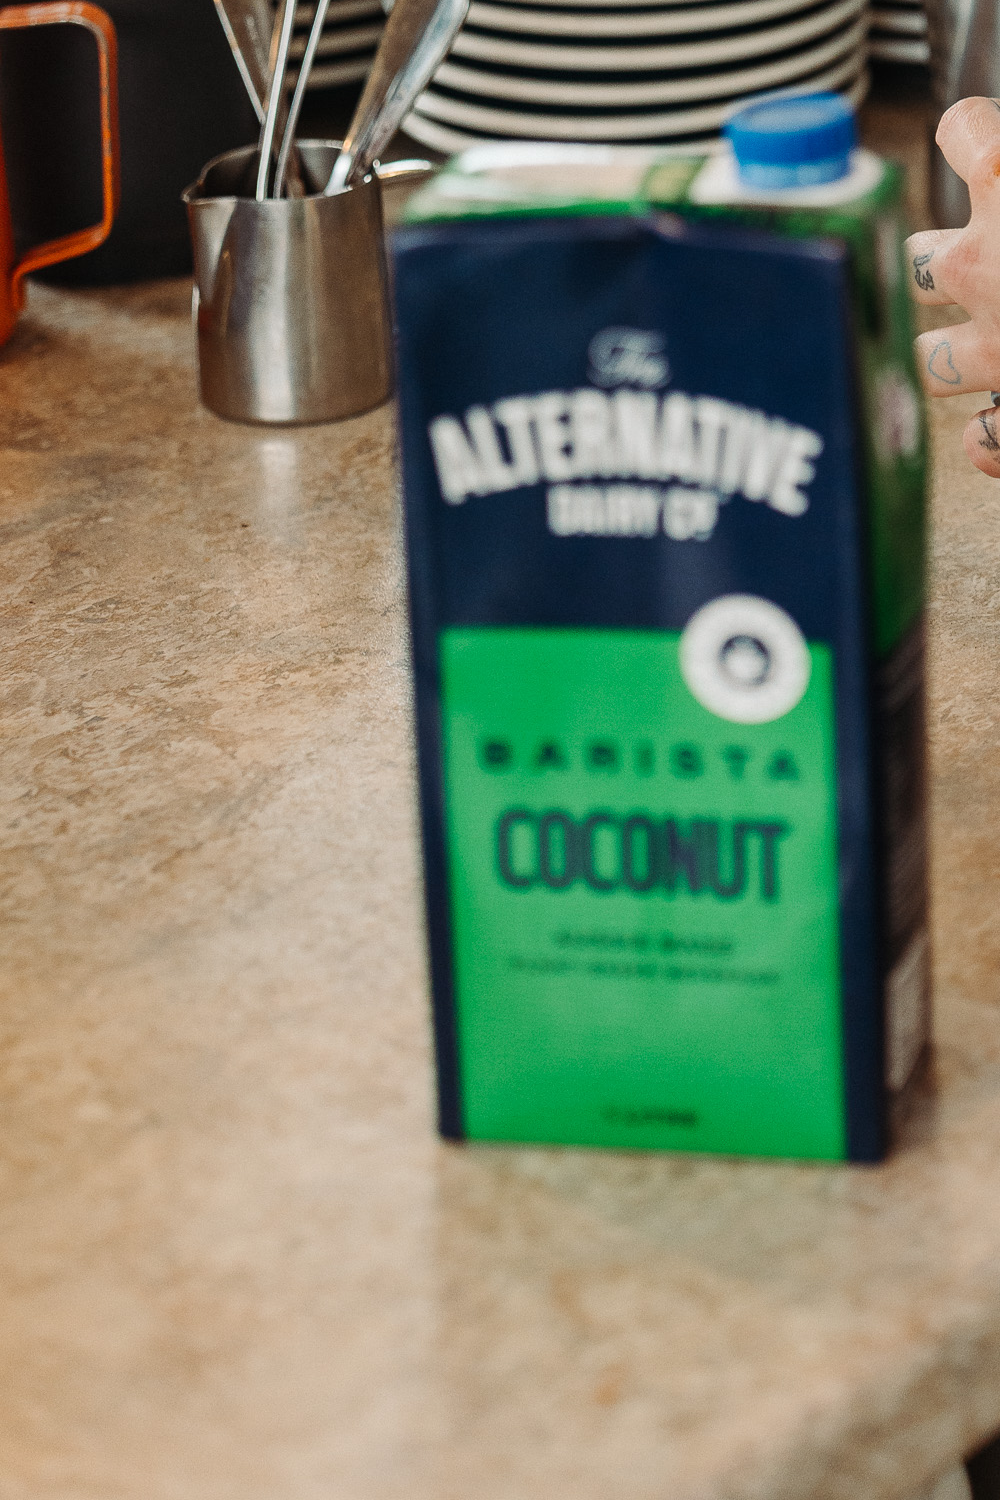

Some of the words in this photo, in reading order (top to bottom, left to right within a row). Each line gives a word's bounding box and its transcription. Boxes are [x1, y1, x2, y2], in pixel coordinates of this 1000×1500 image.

[429, 390, 822, 514] ALTERNATIVE
[482, 736, 798, 780] BARISTA
[498, 808, 788, 901] COCONUT
